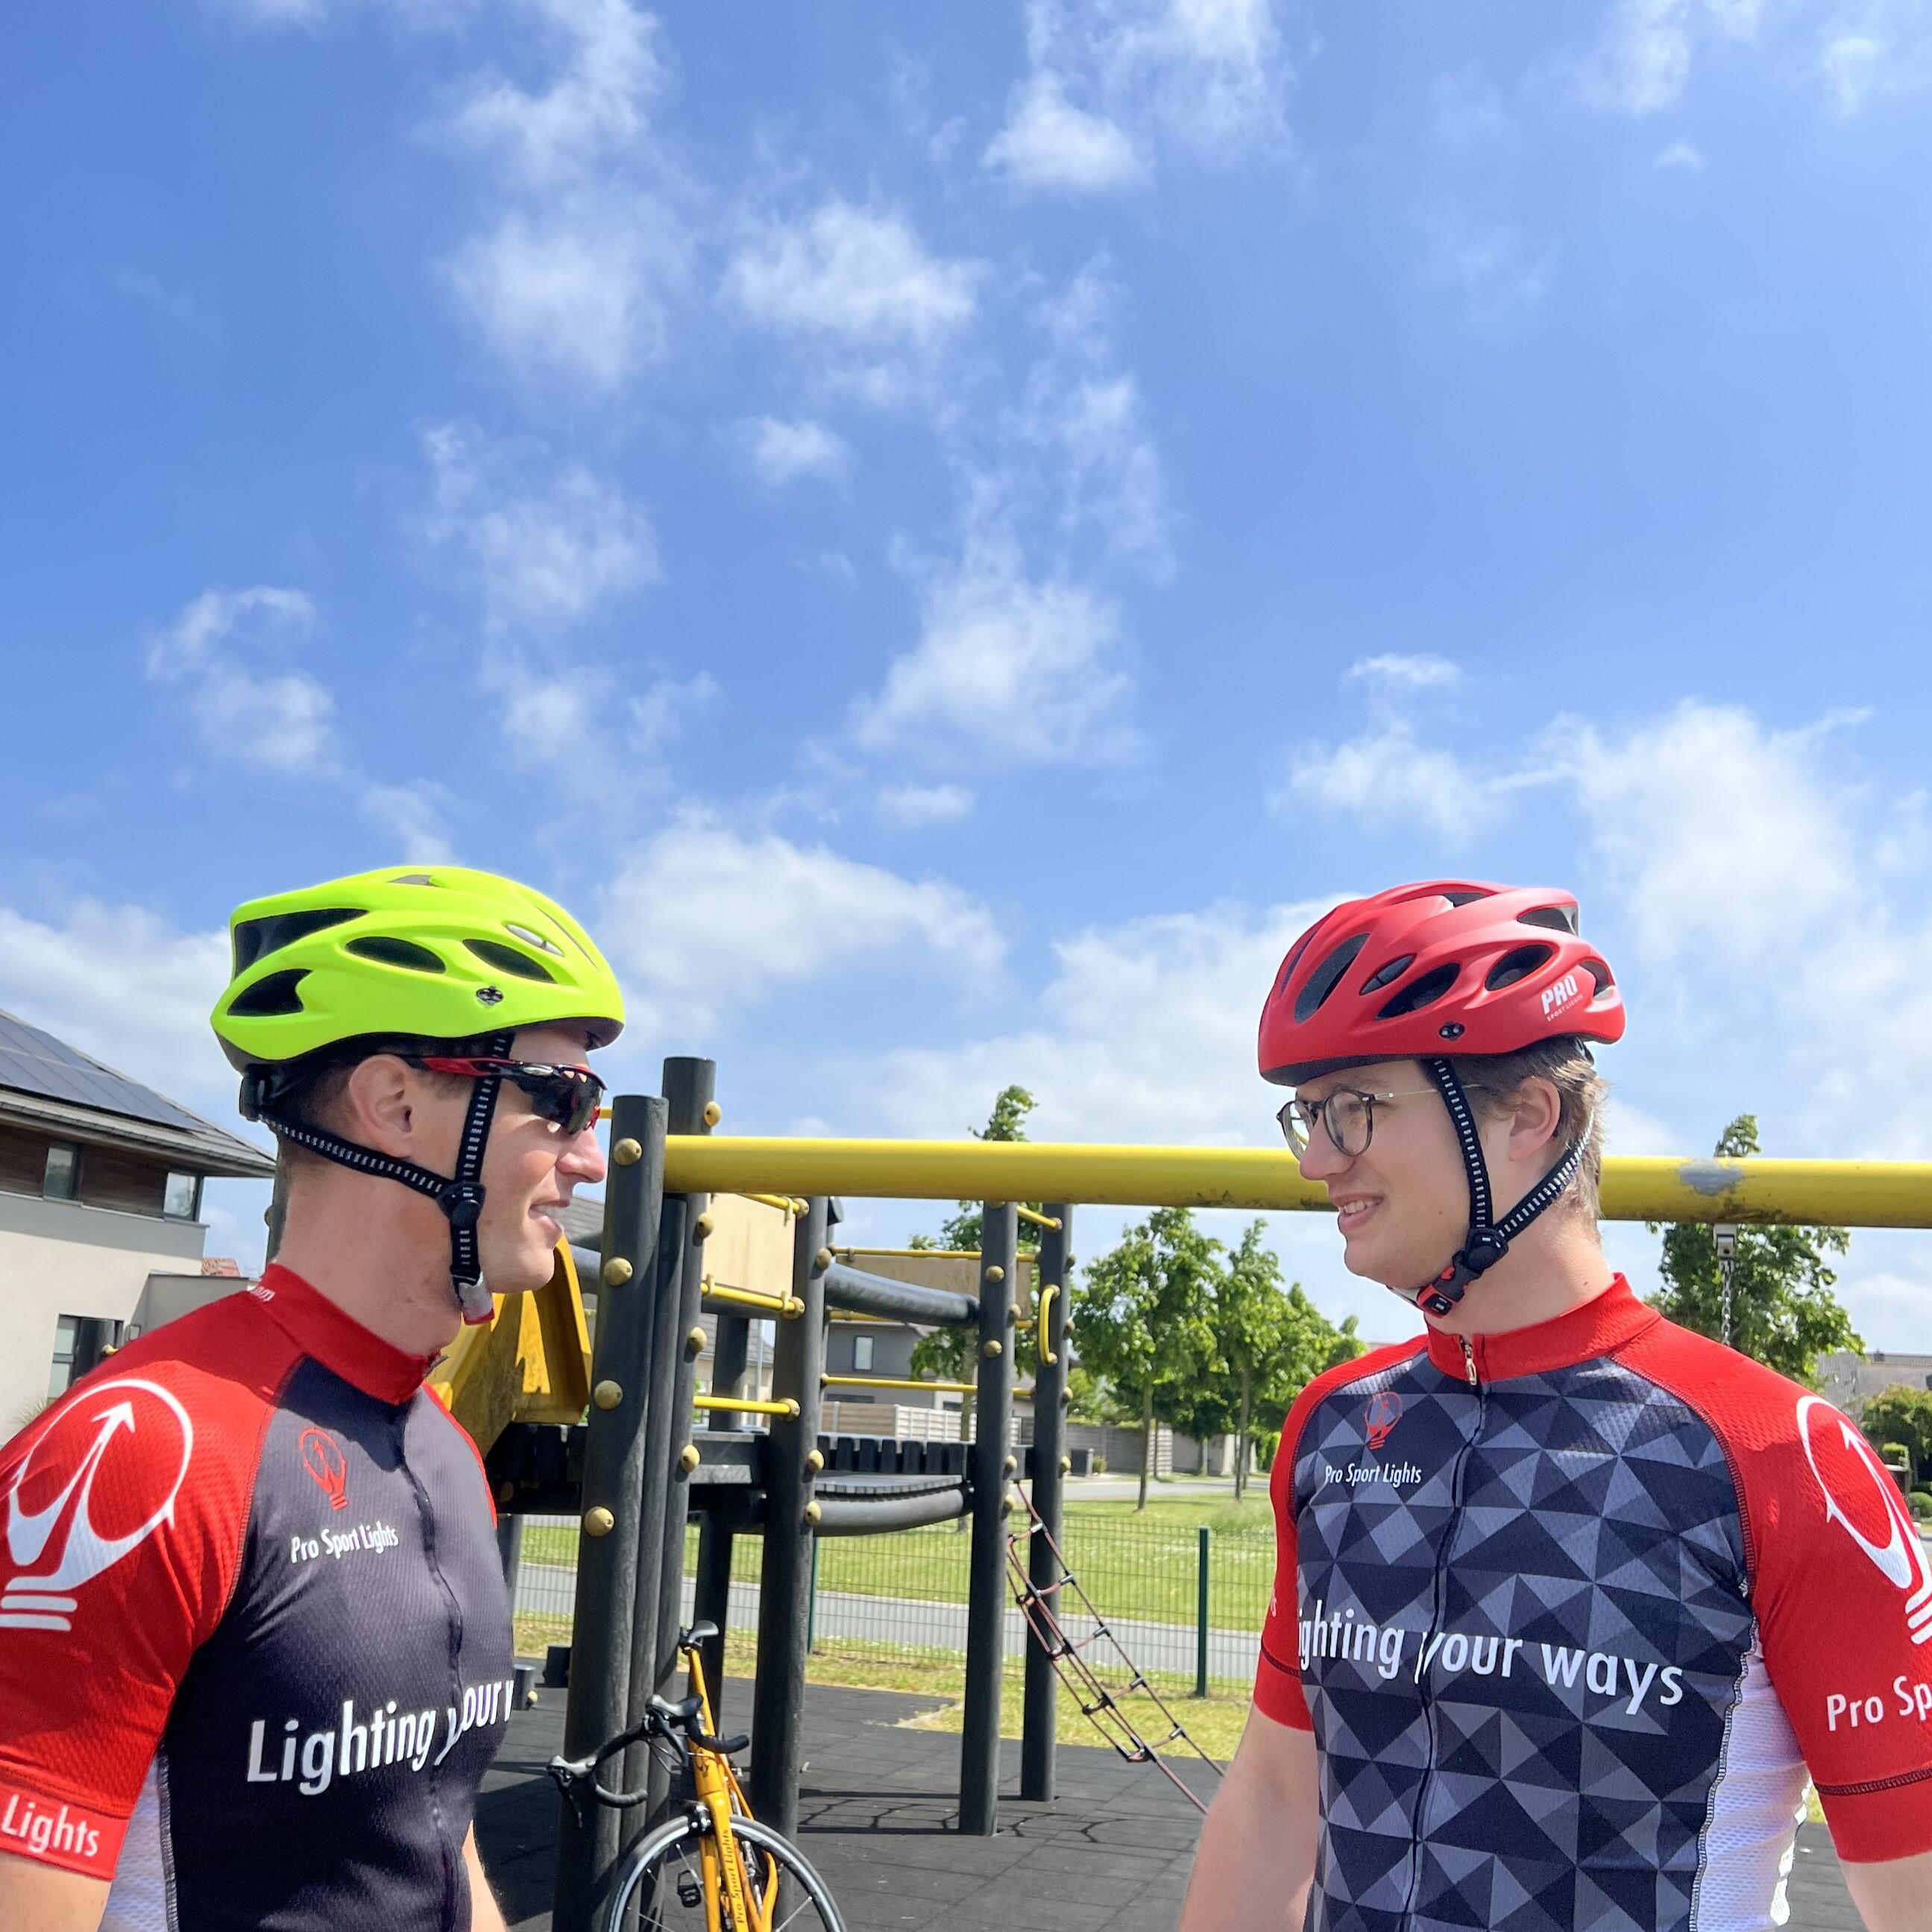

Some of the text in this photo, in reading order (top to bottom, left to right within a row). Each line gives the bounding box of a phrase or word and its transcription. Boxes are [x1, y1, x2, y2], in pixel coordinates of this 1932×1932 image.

[1541, 975, 1578, 1015] PRO
[1324, 1461, 1422, 1488] Pro Sport Lights
[290, 1520, 399, 1564] Pro Sport Lights
[1297, 1599, 1684, 1715] ighting your ways
[247, 1699, 437, 1796] Lighting
[433, 1681, 503, 1766] your
[1826, 1693, 1884, 1731] Pro
[1, 1793, 101, 1857] Lights
[722, 1829, 746, 1924] Pro Sport Lights
